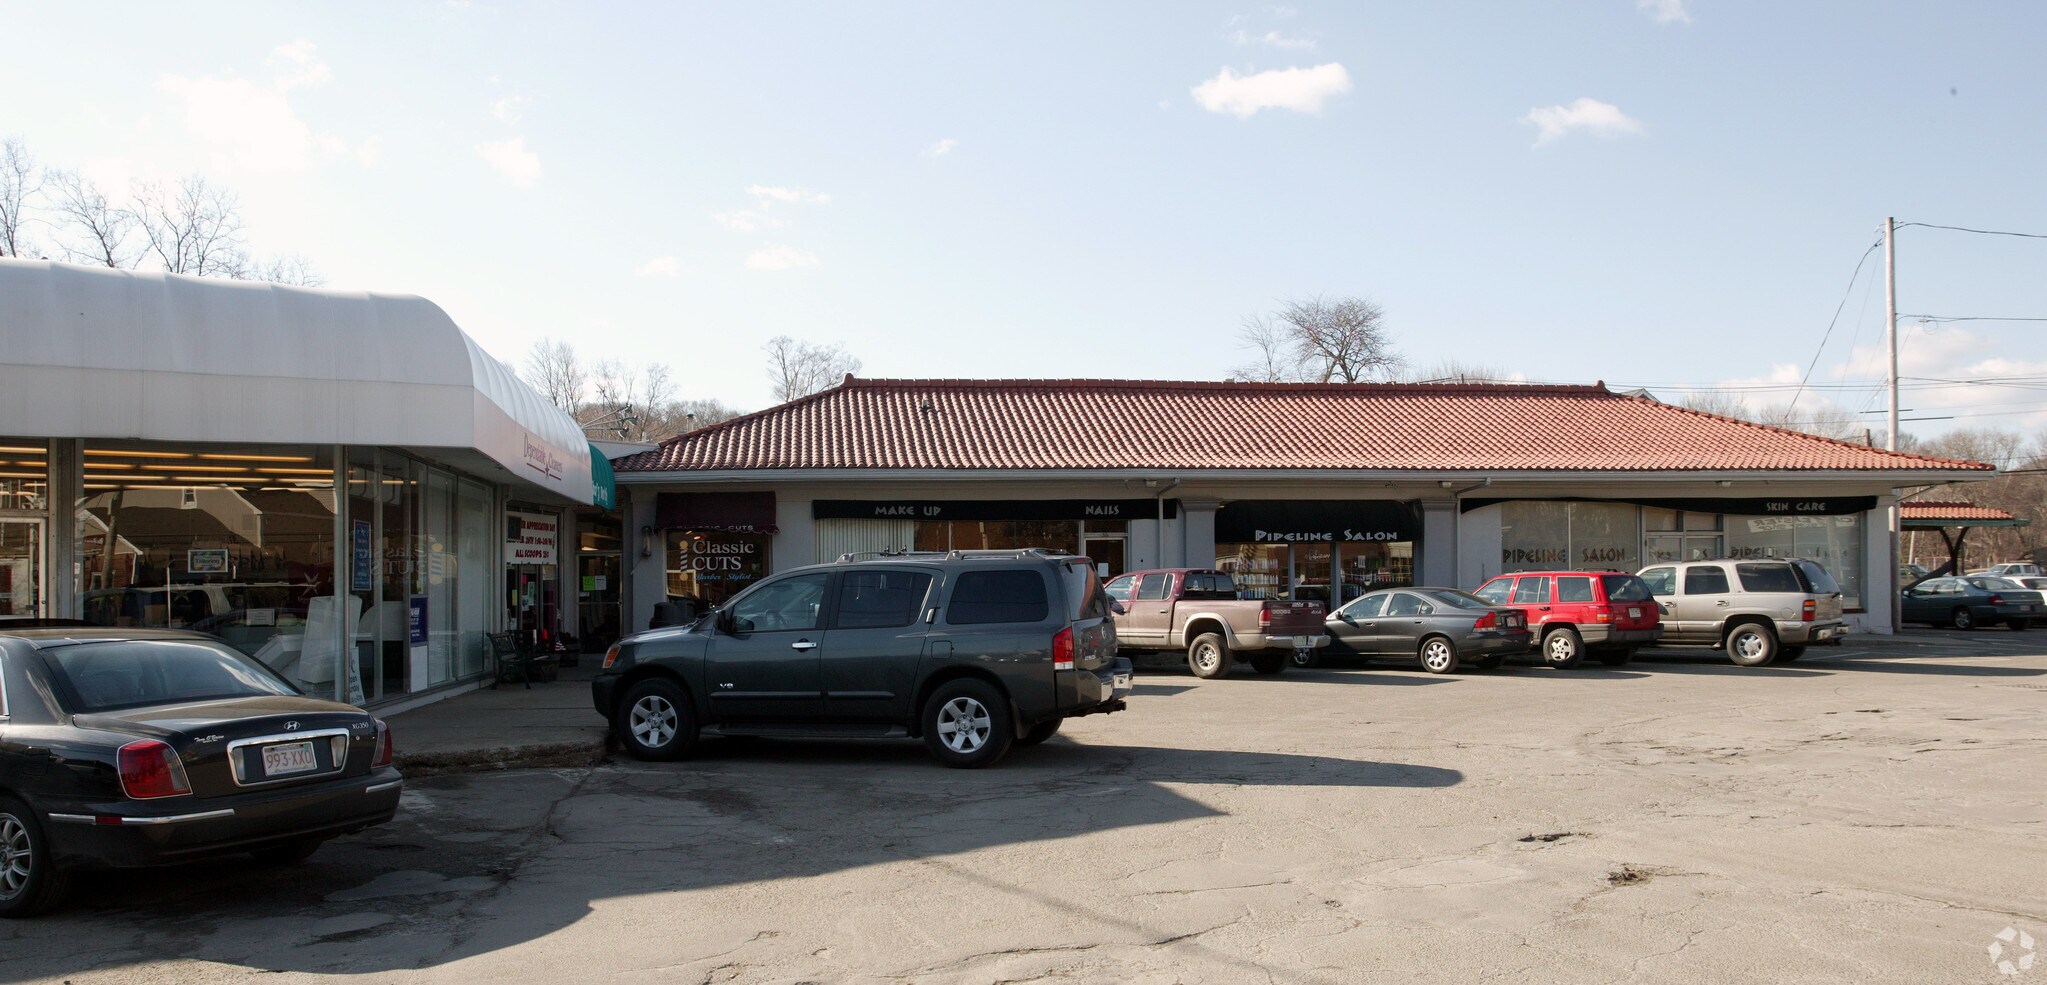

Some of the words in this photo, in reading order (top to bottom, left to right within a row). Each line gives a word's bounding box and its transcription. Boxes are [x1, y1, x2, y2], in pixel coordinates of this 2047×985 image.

[874, 506, 915, 515] MAKE
[923, 506, 942, 516] UP
[1085, 505, 1120, 515] NAILS
[1766, 502, 1789, 511] SKIN
[1795, 502, 1826, 511] CARE
[692, 540, 754, 554] Classic
[515, 549, 524, 558] ALL
[524, 549, 542, 558] SCOOPS
[1502, 549, 1567, 563] PIPELINE
[1582, 548, 1626, 563] SALON
[692, 556, 742, 571] CUTS
[351, 721, 370, 730] XG350
